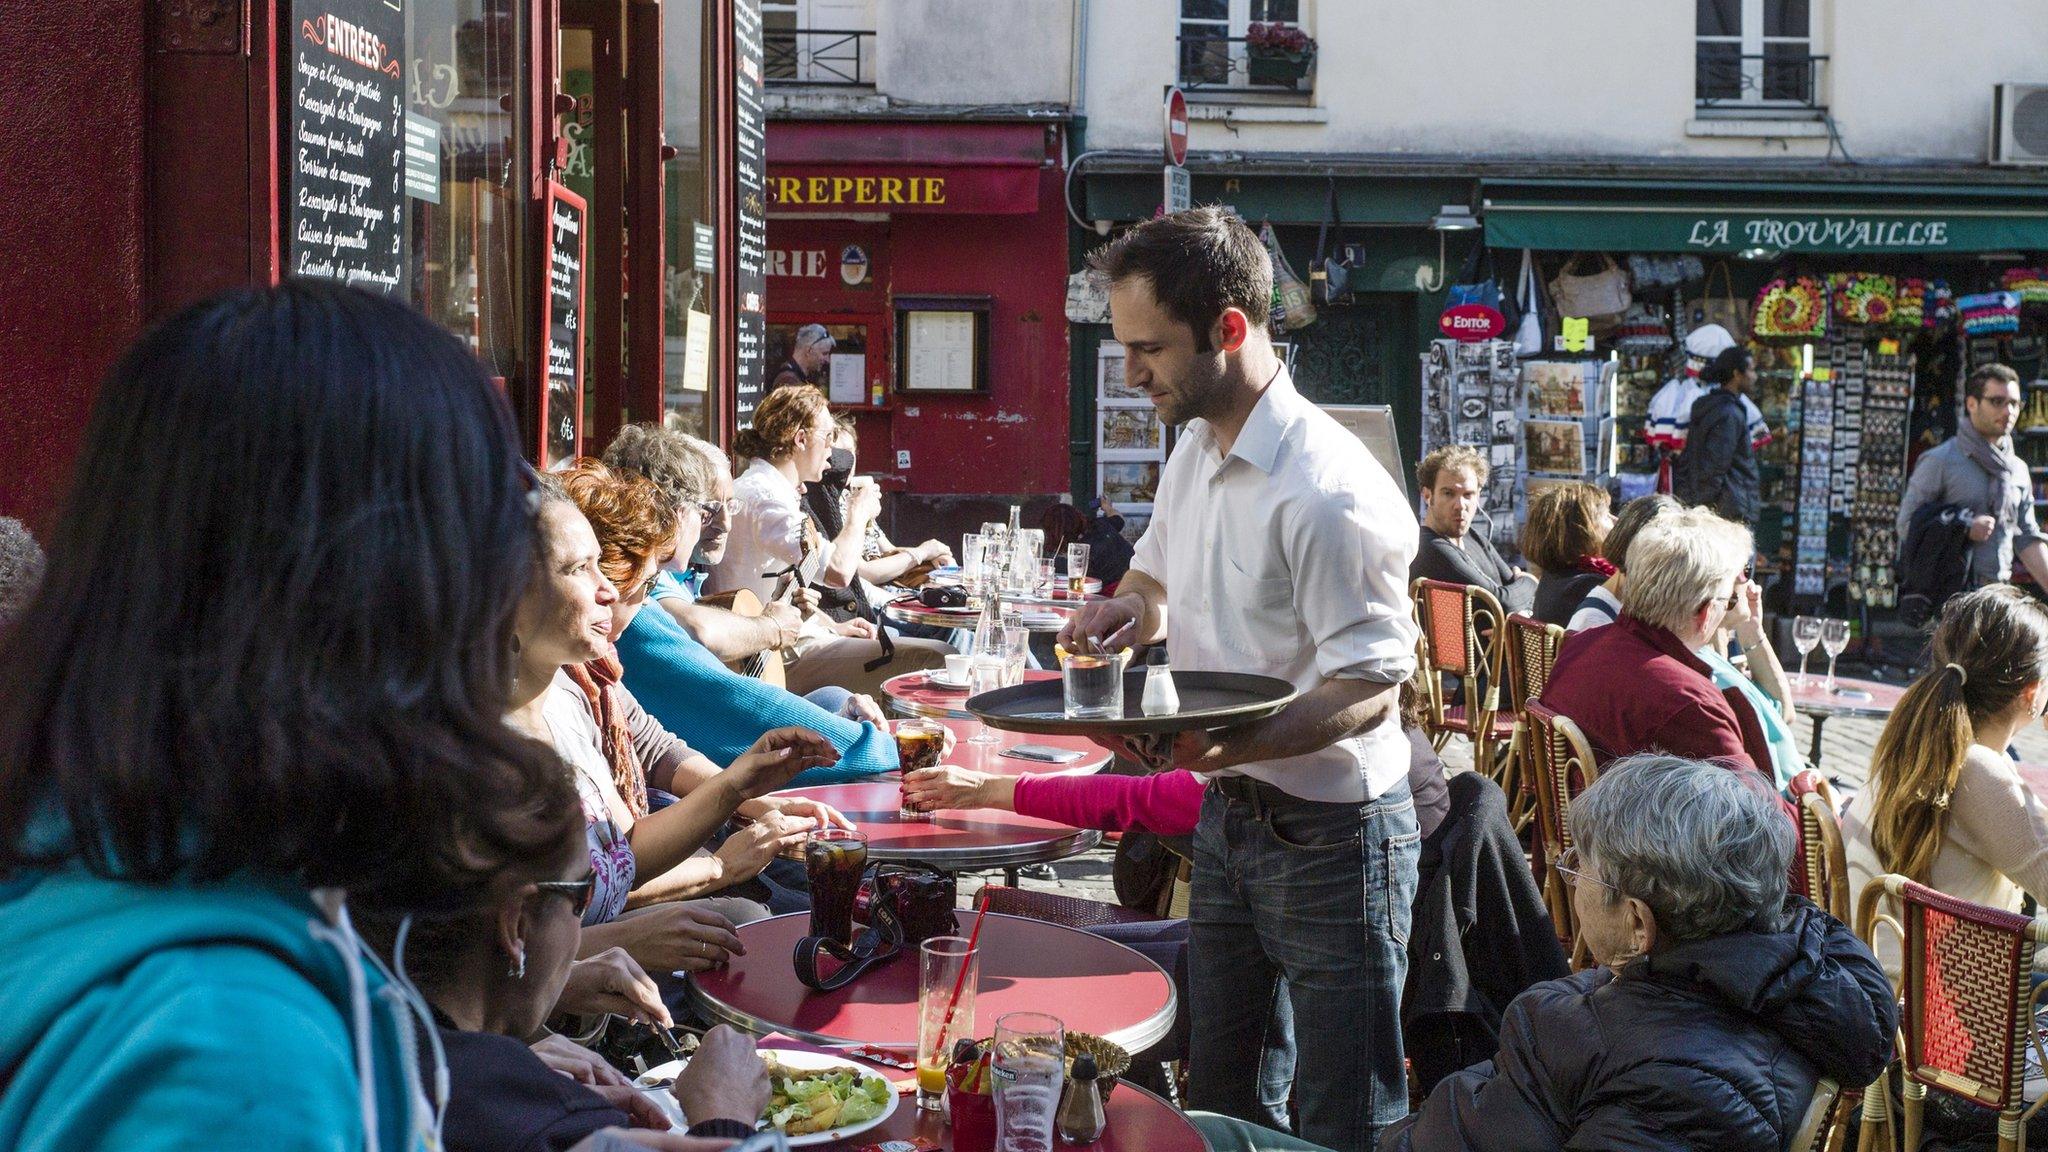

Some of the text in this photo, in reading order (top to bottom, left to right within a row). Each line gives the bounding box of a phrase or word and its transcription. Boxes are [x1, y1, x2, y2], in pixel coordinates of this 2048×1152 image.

[327, 13, 380, 71] ENTRÉES
[299, 52, 319, 86] Soupe
[299, 87, 306, 107] 6
[305, 98, 336, 125] escargots
[337, 101, 347, 121] de
[347, 102, 382, 139] Bourgogne
[299, 120, 327, 147] Saumon
[299, 147, 328, 178] Terrine
[330, 162, 339, 181] de
[339, 170, 372, 198] campagne
[339, 195, 348, 214] de
[348, 194, 383, 231] Bourgogne
[298, 218, 323, 244] Cuisses
[323, 225, 332, 246] de
[332, 229, 367, 257] grenouilles
[1687, 218, 1949, 249] LA TROUVAILLE
[337, 259, 346, 279] de
[1453, 315, 1491, 329] EDITOR
